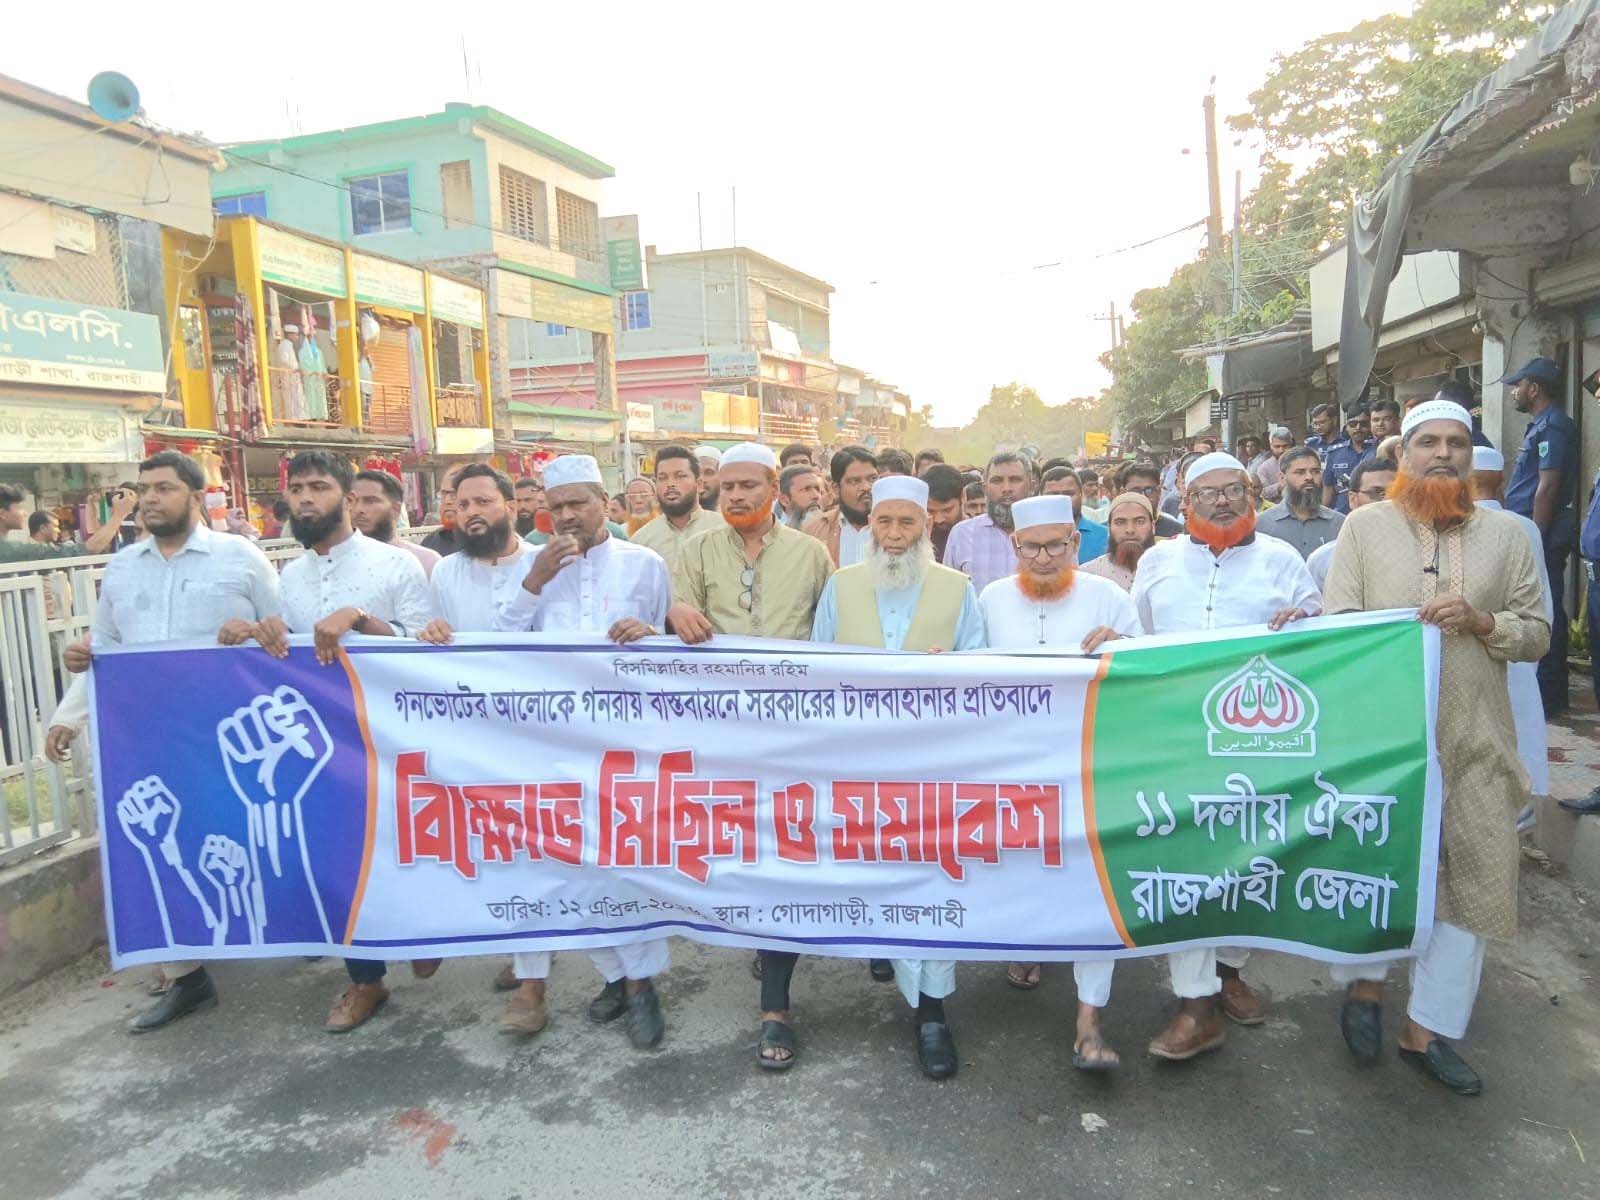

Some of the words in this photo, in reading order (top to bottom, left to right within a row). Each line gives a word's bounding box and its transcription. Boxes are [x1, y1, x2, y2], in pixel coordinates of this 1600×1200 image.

[703, 660, 766, 676] রহমানির
[770, 660, 809, 677] রহিম
[395, 681, 488, 724] গনভোটের
[491, 688, 577, 724] আলোকে
[582, 686, 643, 724] গনরায়
[646, 687, 740, 722] বাস্তবায়নে
[744, 687, 837, 721] সরকারের
[840, 681, 957, 721] টালবাহানার
[963, 681, 1054, 718] প্রতিবাদে
[394, 749, 584, 881] বিক্ষোভ
[595, 748, 758, 886] মিছিল
[772, 781, 820, 865] ও
[831, 780, 1064, 882] সমাবেশ
[1136, 791, 1176, 837] ১১
[1188, 773, 1292, 847] দলীয়
[1304, 771, 1399, 847] ঐক্য
[560, 900, 583, 918] ১২
[713, 903, 750, 924] স্থান
[771, 896, 874, 926] গোদাগাড়ী,
[880, 899, 968, 928] রাজশাহী
[1127, 856, 1286, 925] রাজশাহী
[1295, 867, 1400, 931] জেলা
